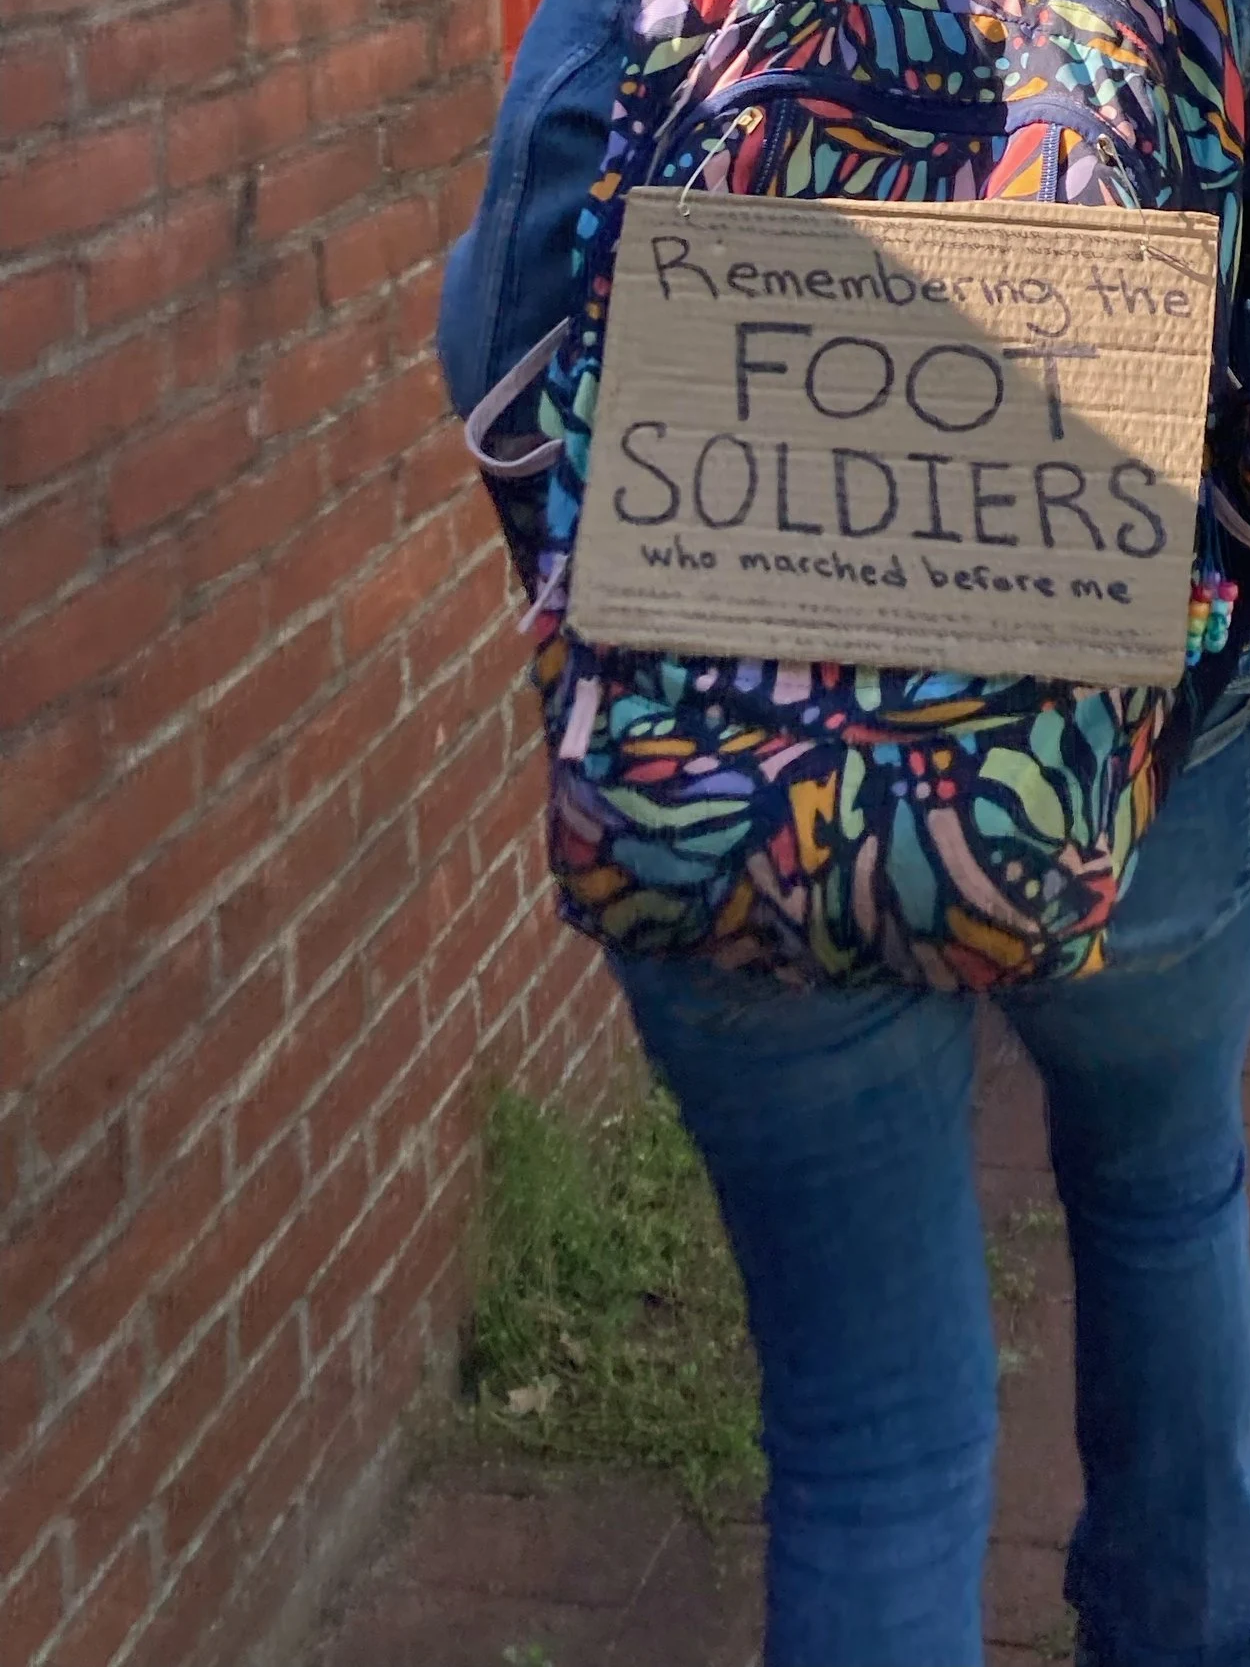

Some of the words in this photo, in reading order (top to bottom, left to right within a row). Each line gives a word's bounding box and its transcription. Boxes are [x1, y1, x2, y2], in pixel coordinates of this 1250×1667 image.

[651, 235, 1072, 338] Remembering
[1086, 265, 1194, 320] the
[734, 321, 1099, 442] FOOT
[614, 420, 1169, 560] SOLDIERS
[640, 536, 718, 571] who
[739, 548, 908, 590] marched
[921, 555, 1055, 598] before
[1072, 577, 1133, 605] me
